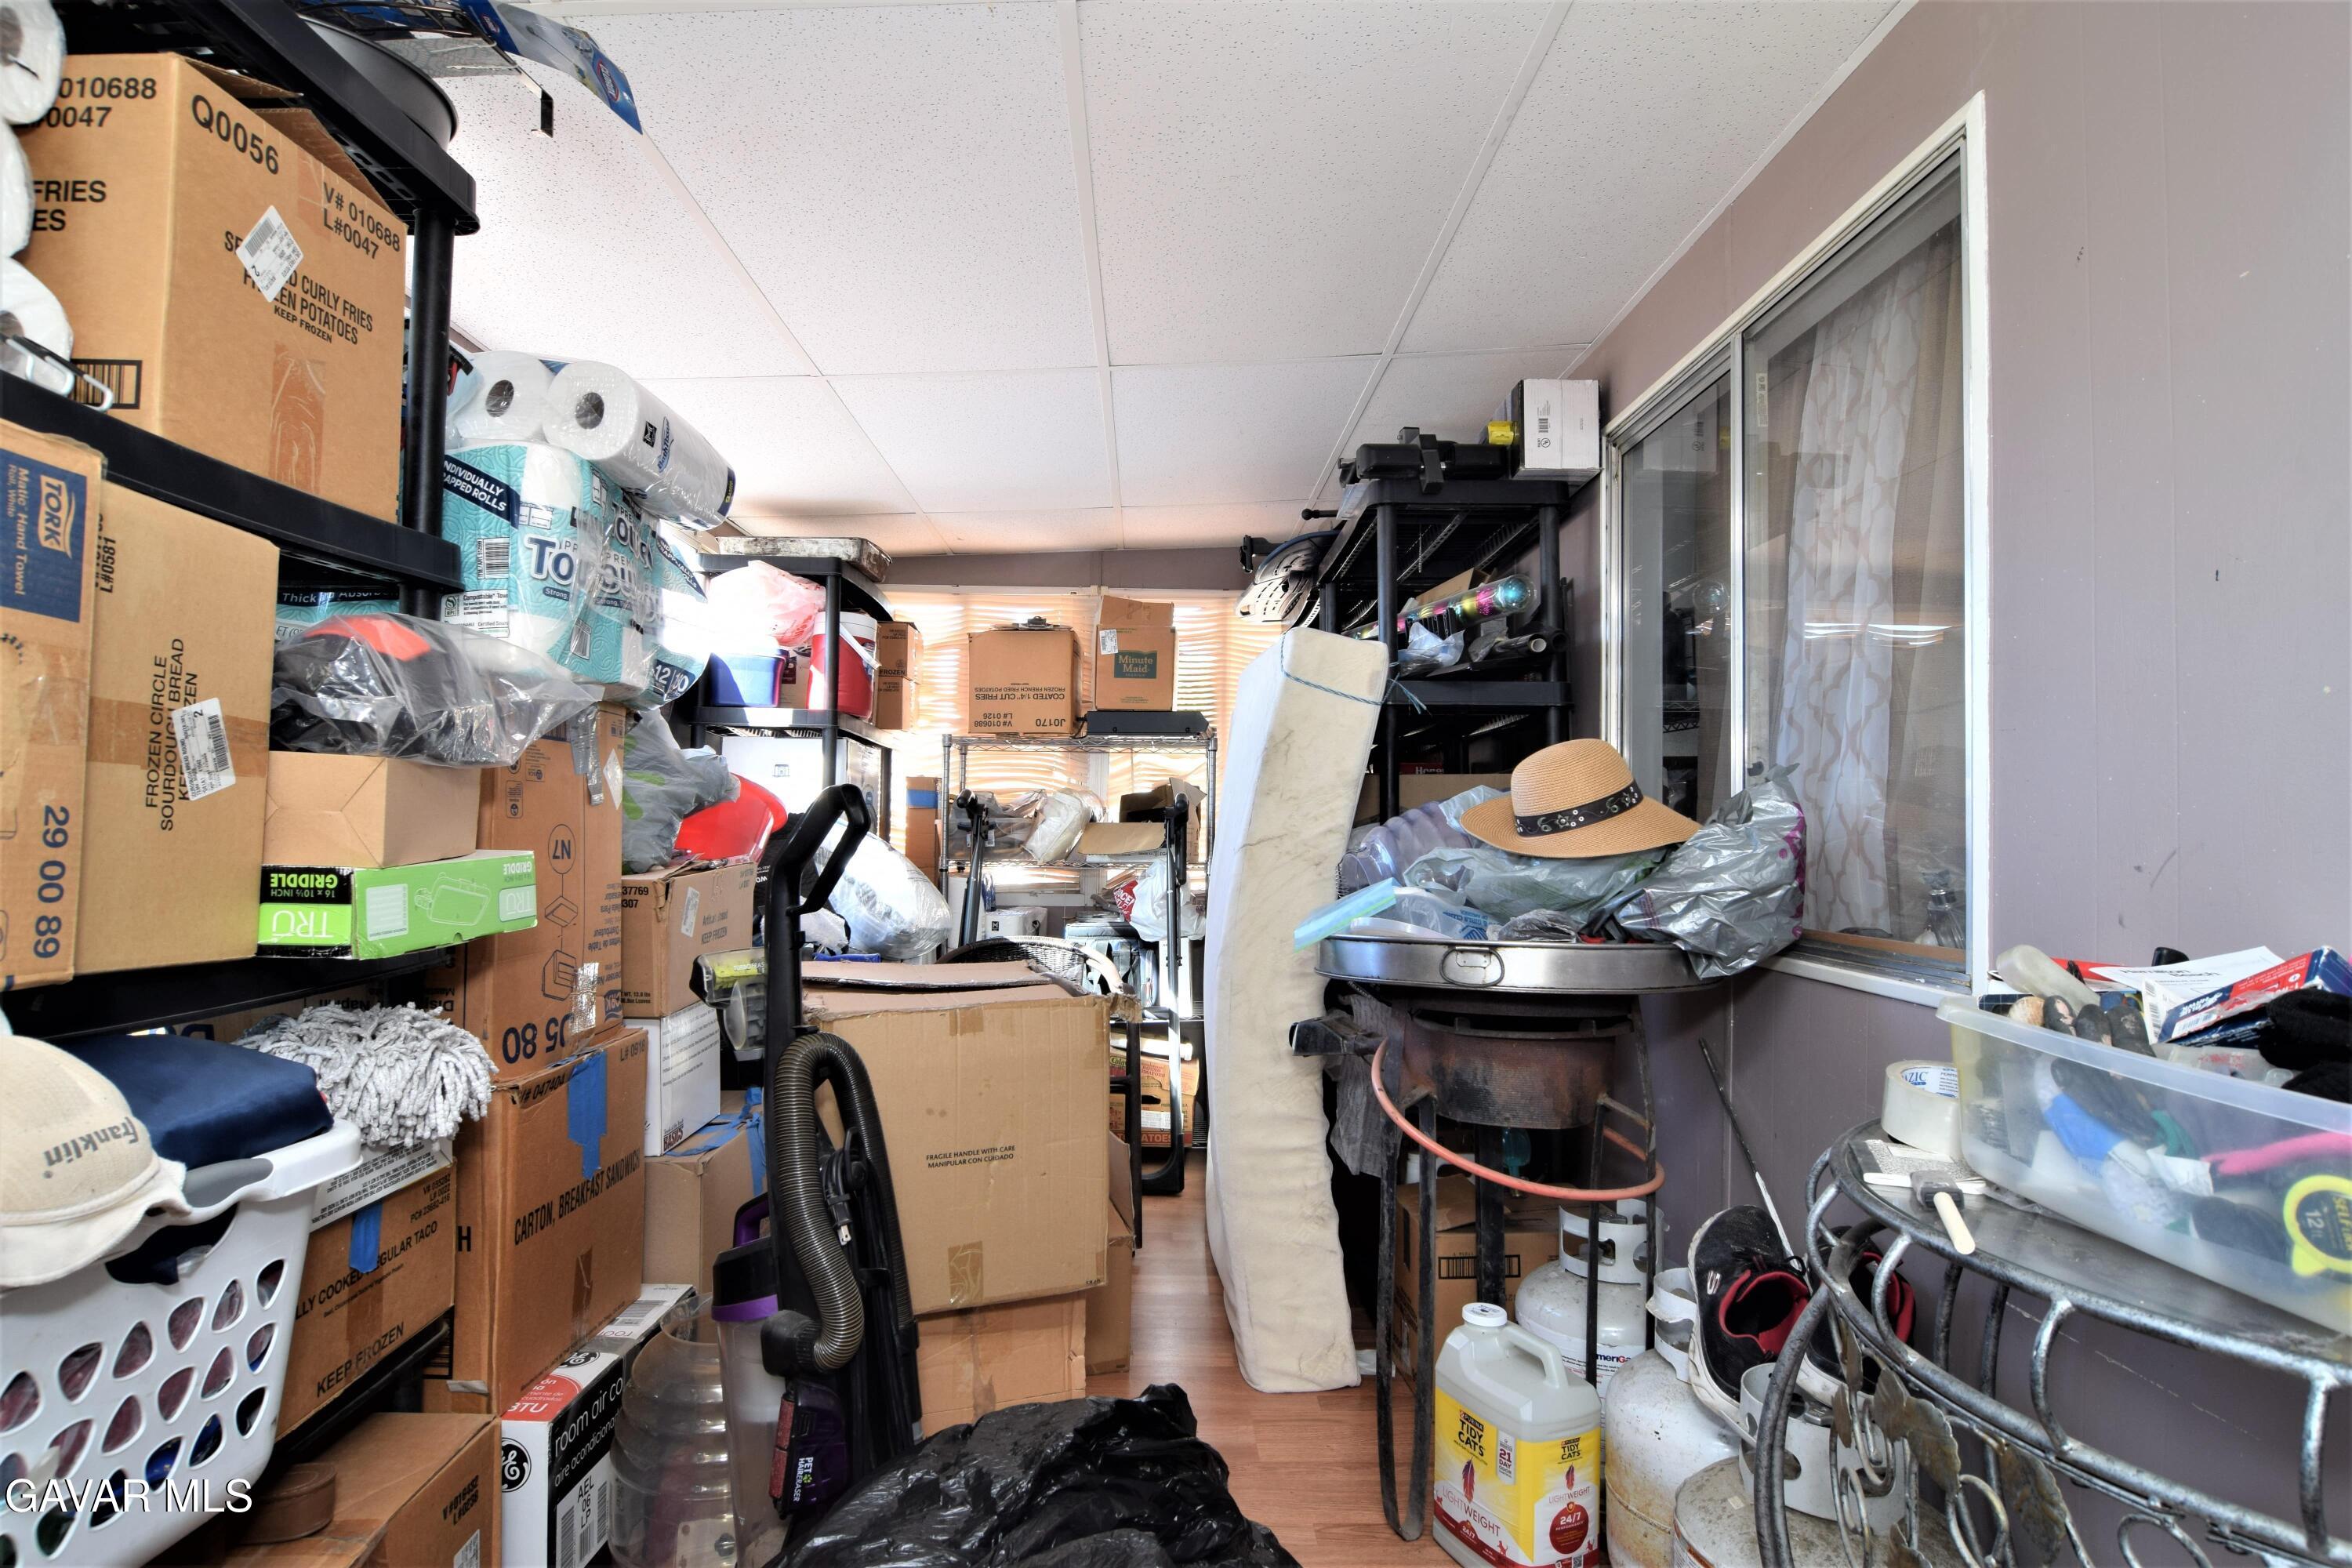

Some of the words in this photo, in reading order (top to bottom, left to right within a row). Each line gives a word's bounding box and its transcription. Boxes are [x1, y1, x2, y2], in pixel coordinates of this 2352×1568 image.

[191, 94, 280, 175] Q0056
[323, 181, 345, 212] V#
[348, 201, 401, 252] 010688
[323, 207, 379, 260] L#0047
[301, 274, 341, 312] CURLY
[342, 299, 374, 332] FRIES
[274, 304, 298, 324] KEEP
[299, 319, 332, 344] FROZEN
[299, 296, 358, 346] POTATOES
[17, 467, 30, 505] Matic
[443, 460, 504, 496] NDIVIDUALLY
[7, 490, 17, 517] White
[443, 474, 473, 494] APPED
[471, 488, 507, 512] ROLLS
[45, 482, 62, 548] TORK
[18, 510, 30, 550] Hand
[14, 554, 28, 597] Towel
[100, 538, 117, 594] L#0581
[282, 593, 317, 604] Thick
[545, 588, 569, 600] Strong.
[169, 638, 185, 703] BREAD
[1119, 655, 1154, 665] Minute
[1122, 663, 1148, 673] Maid
[655, 664, 671, 684] 12
[150, 655, 167, 727] CIRCLE
[975, 692, 998, 701] FRIES
[1000, 692, 1016, 701] CUT
[1033, 692, 1065, 701] COATED
[1035, 718, 1066, 728] J0170
[146, 730, 162, 809] FROZEN
[42, 804, 70, 848] 29
[552, 838, 572, 861] N7
[38, 859, 67, 903] 00
[270, 873, 339, 889] GRIDDLE
[503, 861, 532, 876] GRIDDLE
[270, 888, 293, 897] INCH
[325, 889, 336, 898] 16
[33, 914, 62, 959] 89
[502, 1023, 538, 1065] 80
[43, 1116, 140, 1167] franklin
[927, 1159, 967, 1169] MANIPULAR
[983, 1153, 1014, 1162] CUIDADO
[423, 1185, 431, 1196] V#
[429, 1192, 438, 1203] L#
[514, 1200, 555, 1247] CARTON,
[558, 1170, 604, 1219] BREAKFAST
[605, 1146, 641, 1190] SANDWICH
[2305, 1209, 2325, 1229] 12
[318, 1268, 363, 1305] COOKED
[413, 1220, 438, 1246] TACO
[316, 1359, 353, 1398] KEEP
[354, 1321, 405, 1368] FROZEN
[554, 1410, 588, 1458] room
[591, 1390, 608, 1421] air
[1459, 1418, 1484, 1444] TIDY
[1465, 1414, 1484, 1432] PURINA
[1457, 1430, 1485, 1457] CATS
[1498, 1448, 1512, 1464] 21
[1561, 1443, 1580, 1454] TIDY
[1561, 1450, 1581, 1461] CATS
[554, 1463, 570, 1488] aire
[804, 1457, 814, 1474] PET
[1498, 1459, 1512, 1470] DAY
[577, 1474, 595, 1504] AEL
[793, 1457, 805, 1503] HAIRERASER
[582, 1494, 592, 1513] 06
[1548, 1486, 1591, 1504] LIGHTWEIGHT
[580, 1508, 592, 1529] LP
[1443, 1485, 1501, 1537] LIGHTWEIGHT
[1559, 1512, 1581, 1526] 24/7
[1461, 1526, 1476, 1539] 24/7
